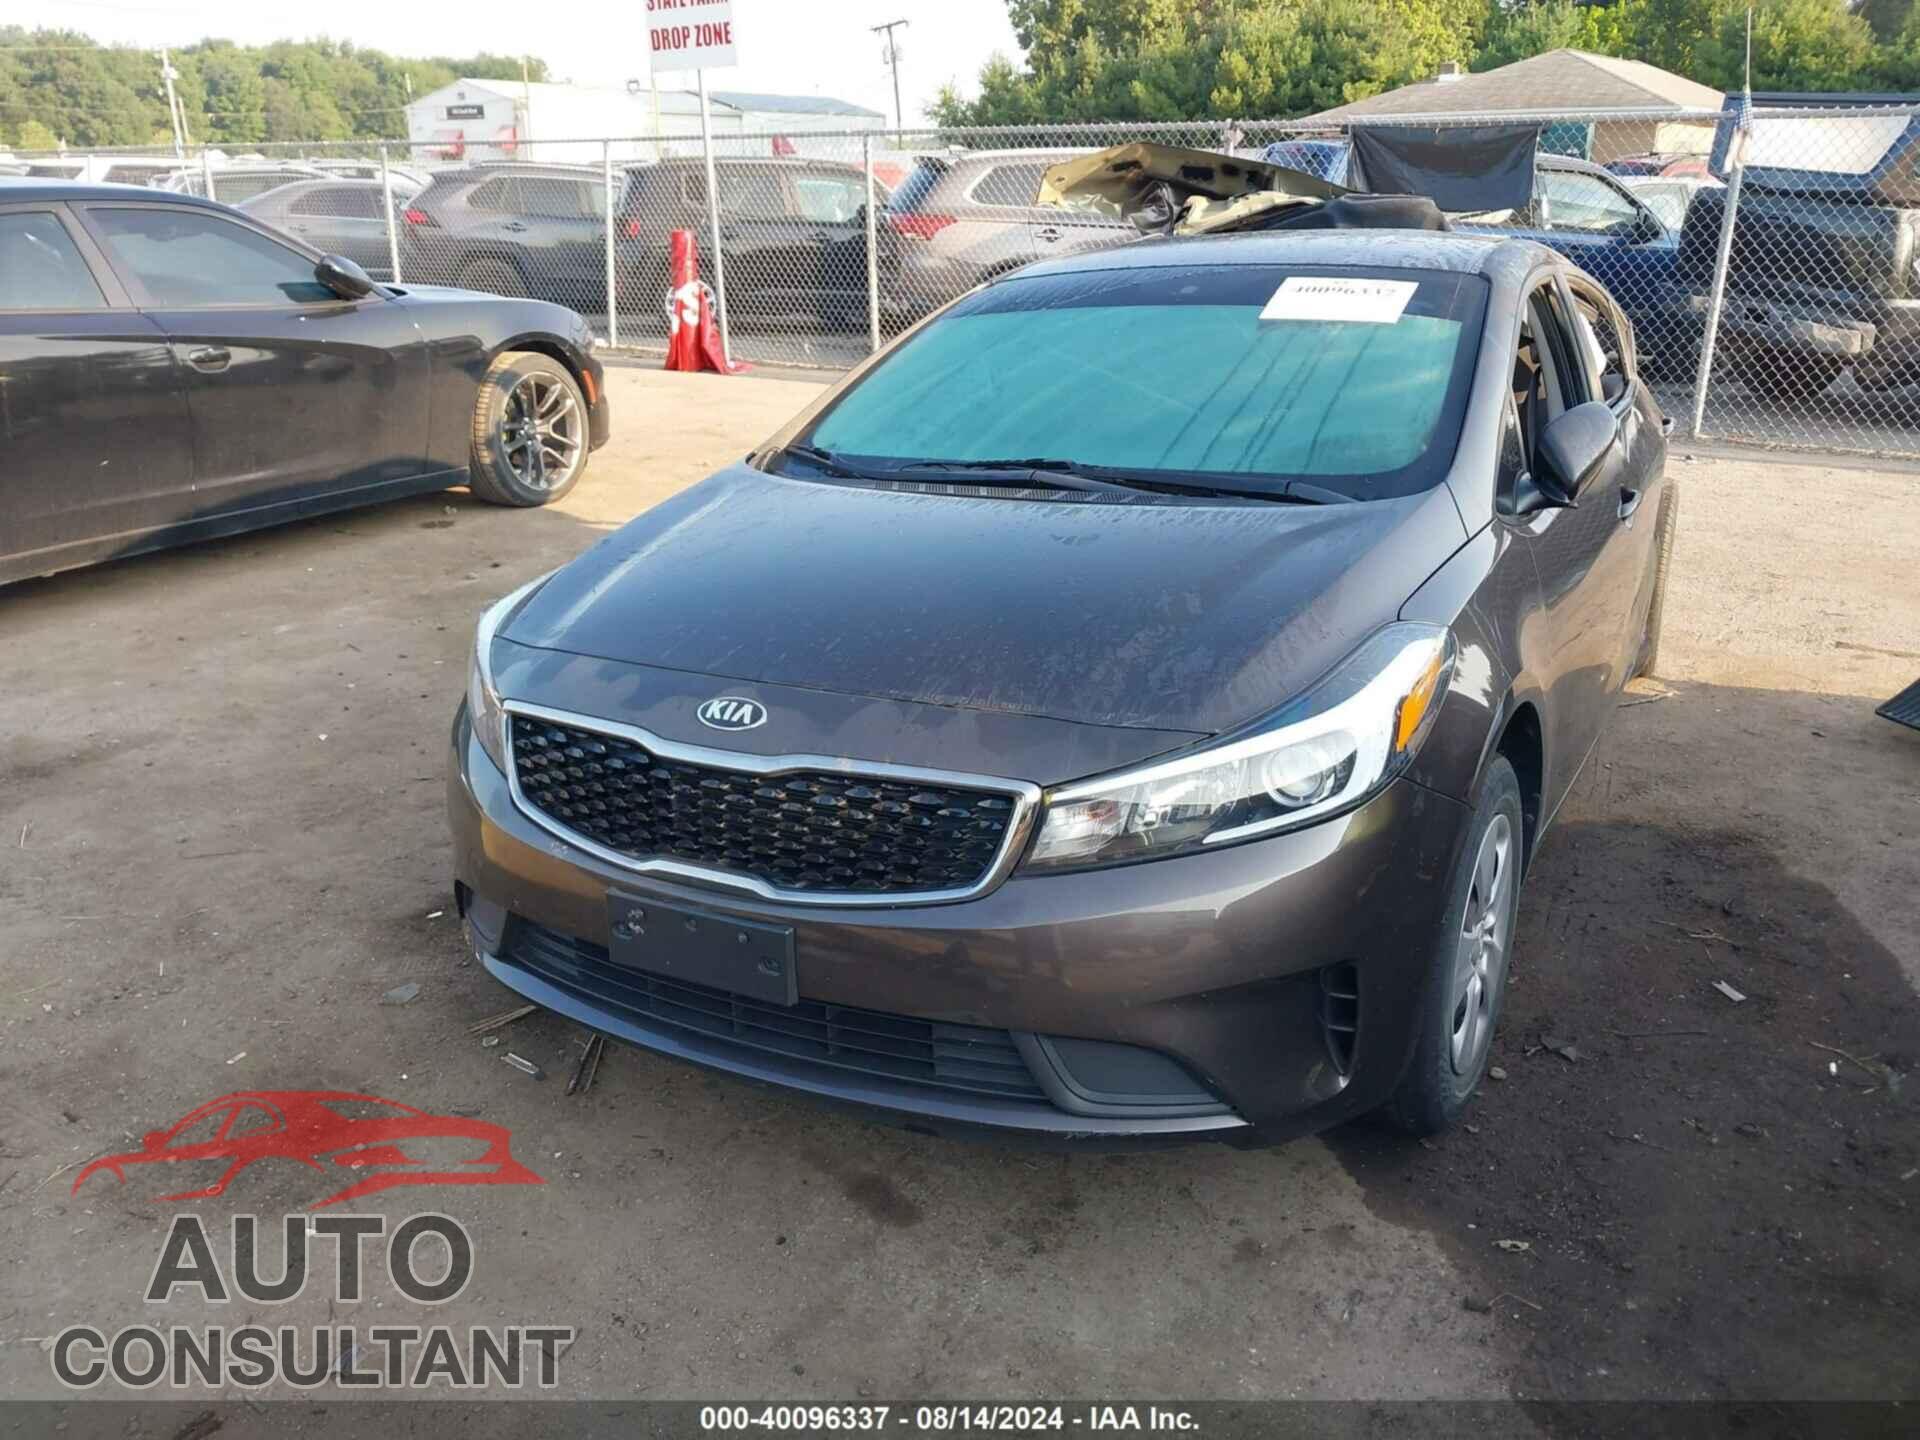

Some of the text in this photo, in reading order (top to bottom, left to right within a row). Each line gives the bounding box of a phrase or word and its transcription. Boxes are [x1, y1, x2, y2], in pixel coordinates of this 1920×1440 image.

[650, 22, 732, 51] DROP ZONE
[705, 700, 753, 724] KIA
